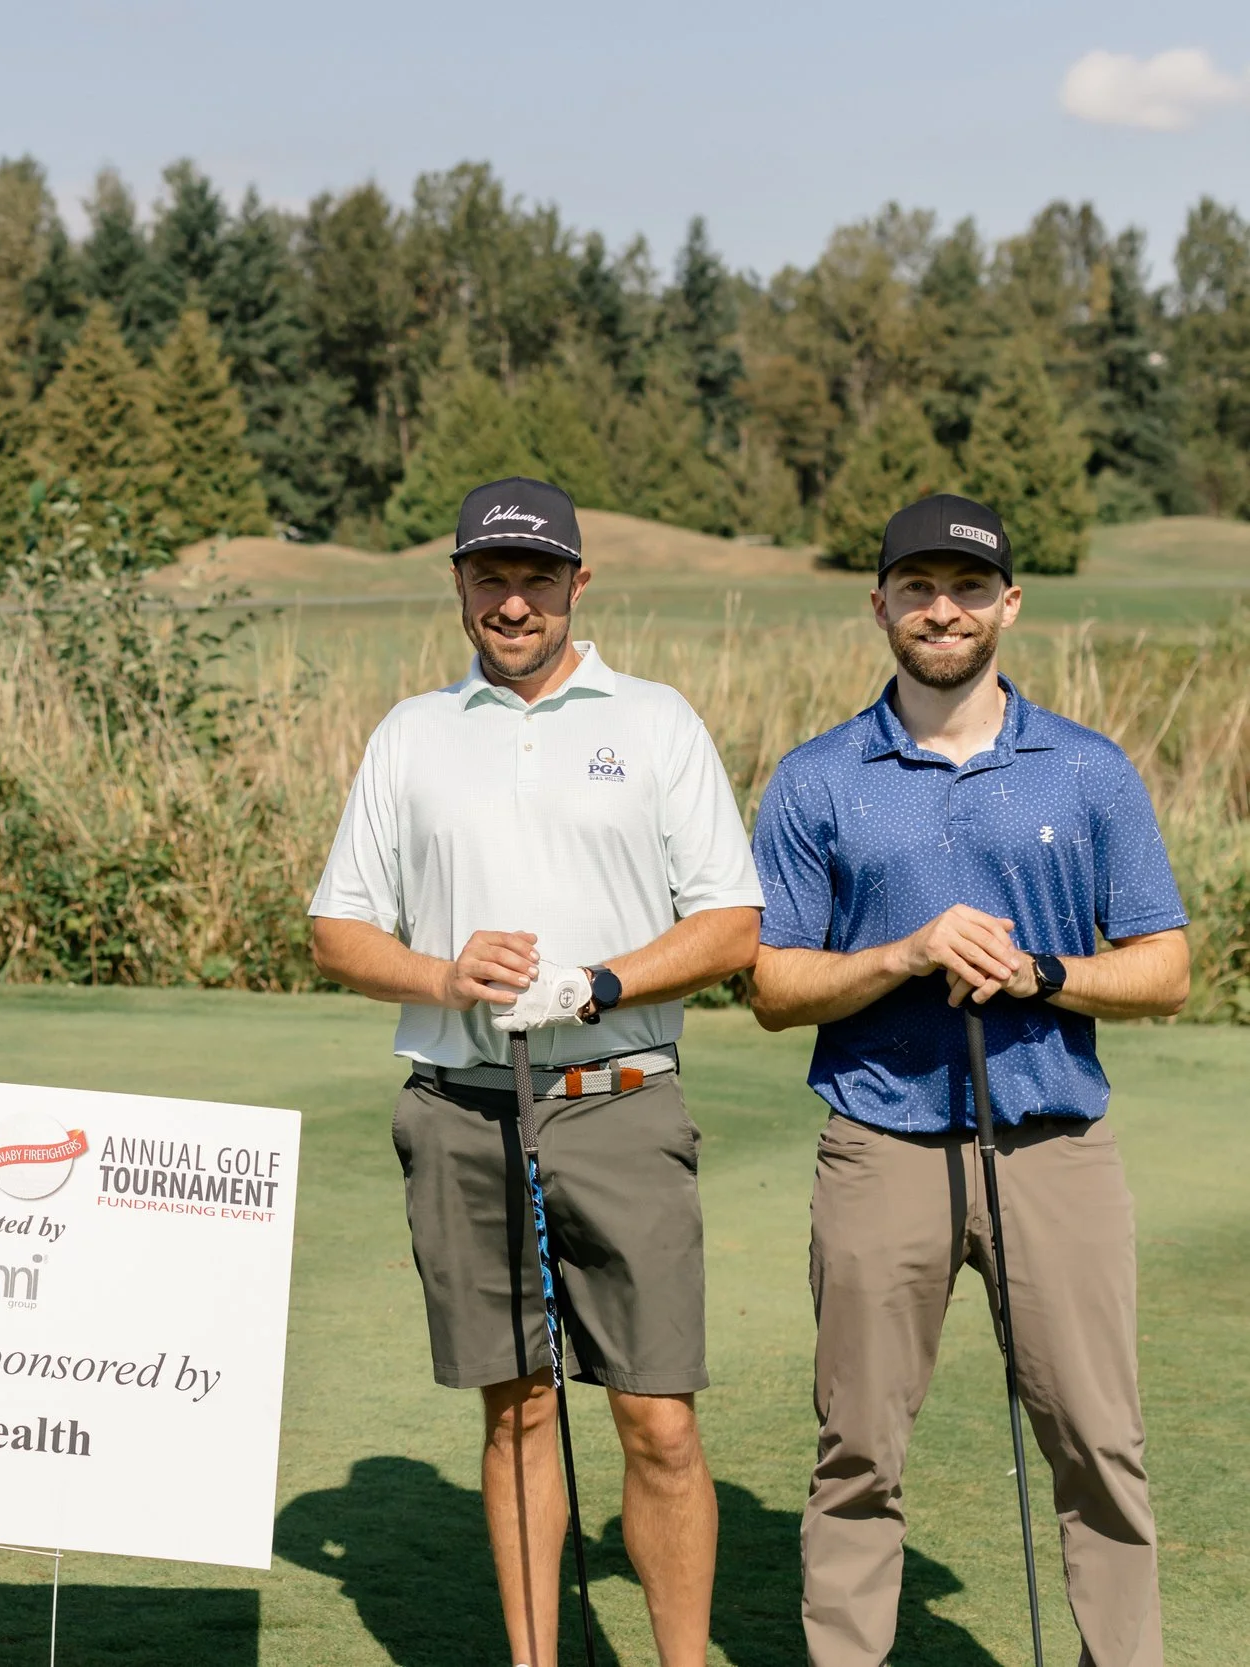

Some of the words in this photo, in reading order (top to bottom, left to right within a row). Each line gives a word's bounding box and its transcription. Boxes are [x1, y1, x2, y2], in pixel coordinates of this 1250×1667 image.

[482, 505, 548, 531] Callaway
[965, 529, 995, 545] DELTA
[588, 764, 626, 776] PGA
[23, 1139, 82, 1161] FIREFIGHTERS
[100, 1136, 206, 1171] ANNUAL
[217, 1147, 281, 1178] GOLF
[99, 1165, 279, 1208] TOURNAMENT
[97, 1196, 216, 1217] FUNDRAISING
[221, 1208, 276, 1223] EVENT
[38, 1216, 66, 1243] by
[7, 1300, 37, 1310] group
[174, 1355, 221, 1402] by
